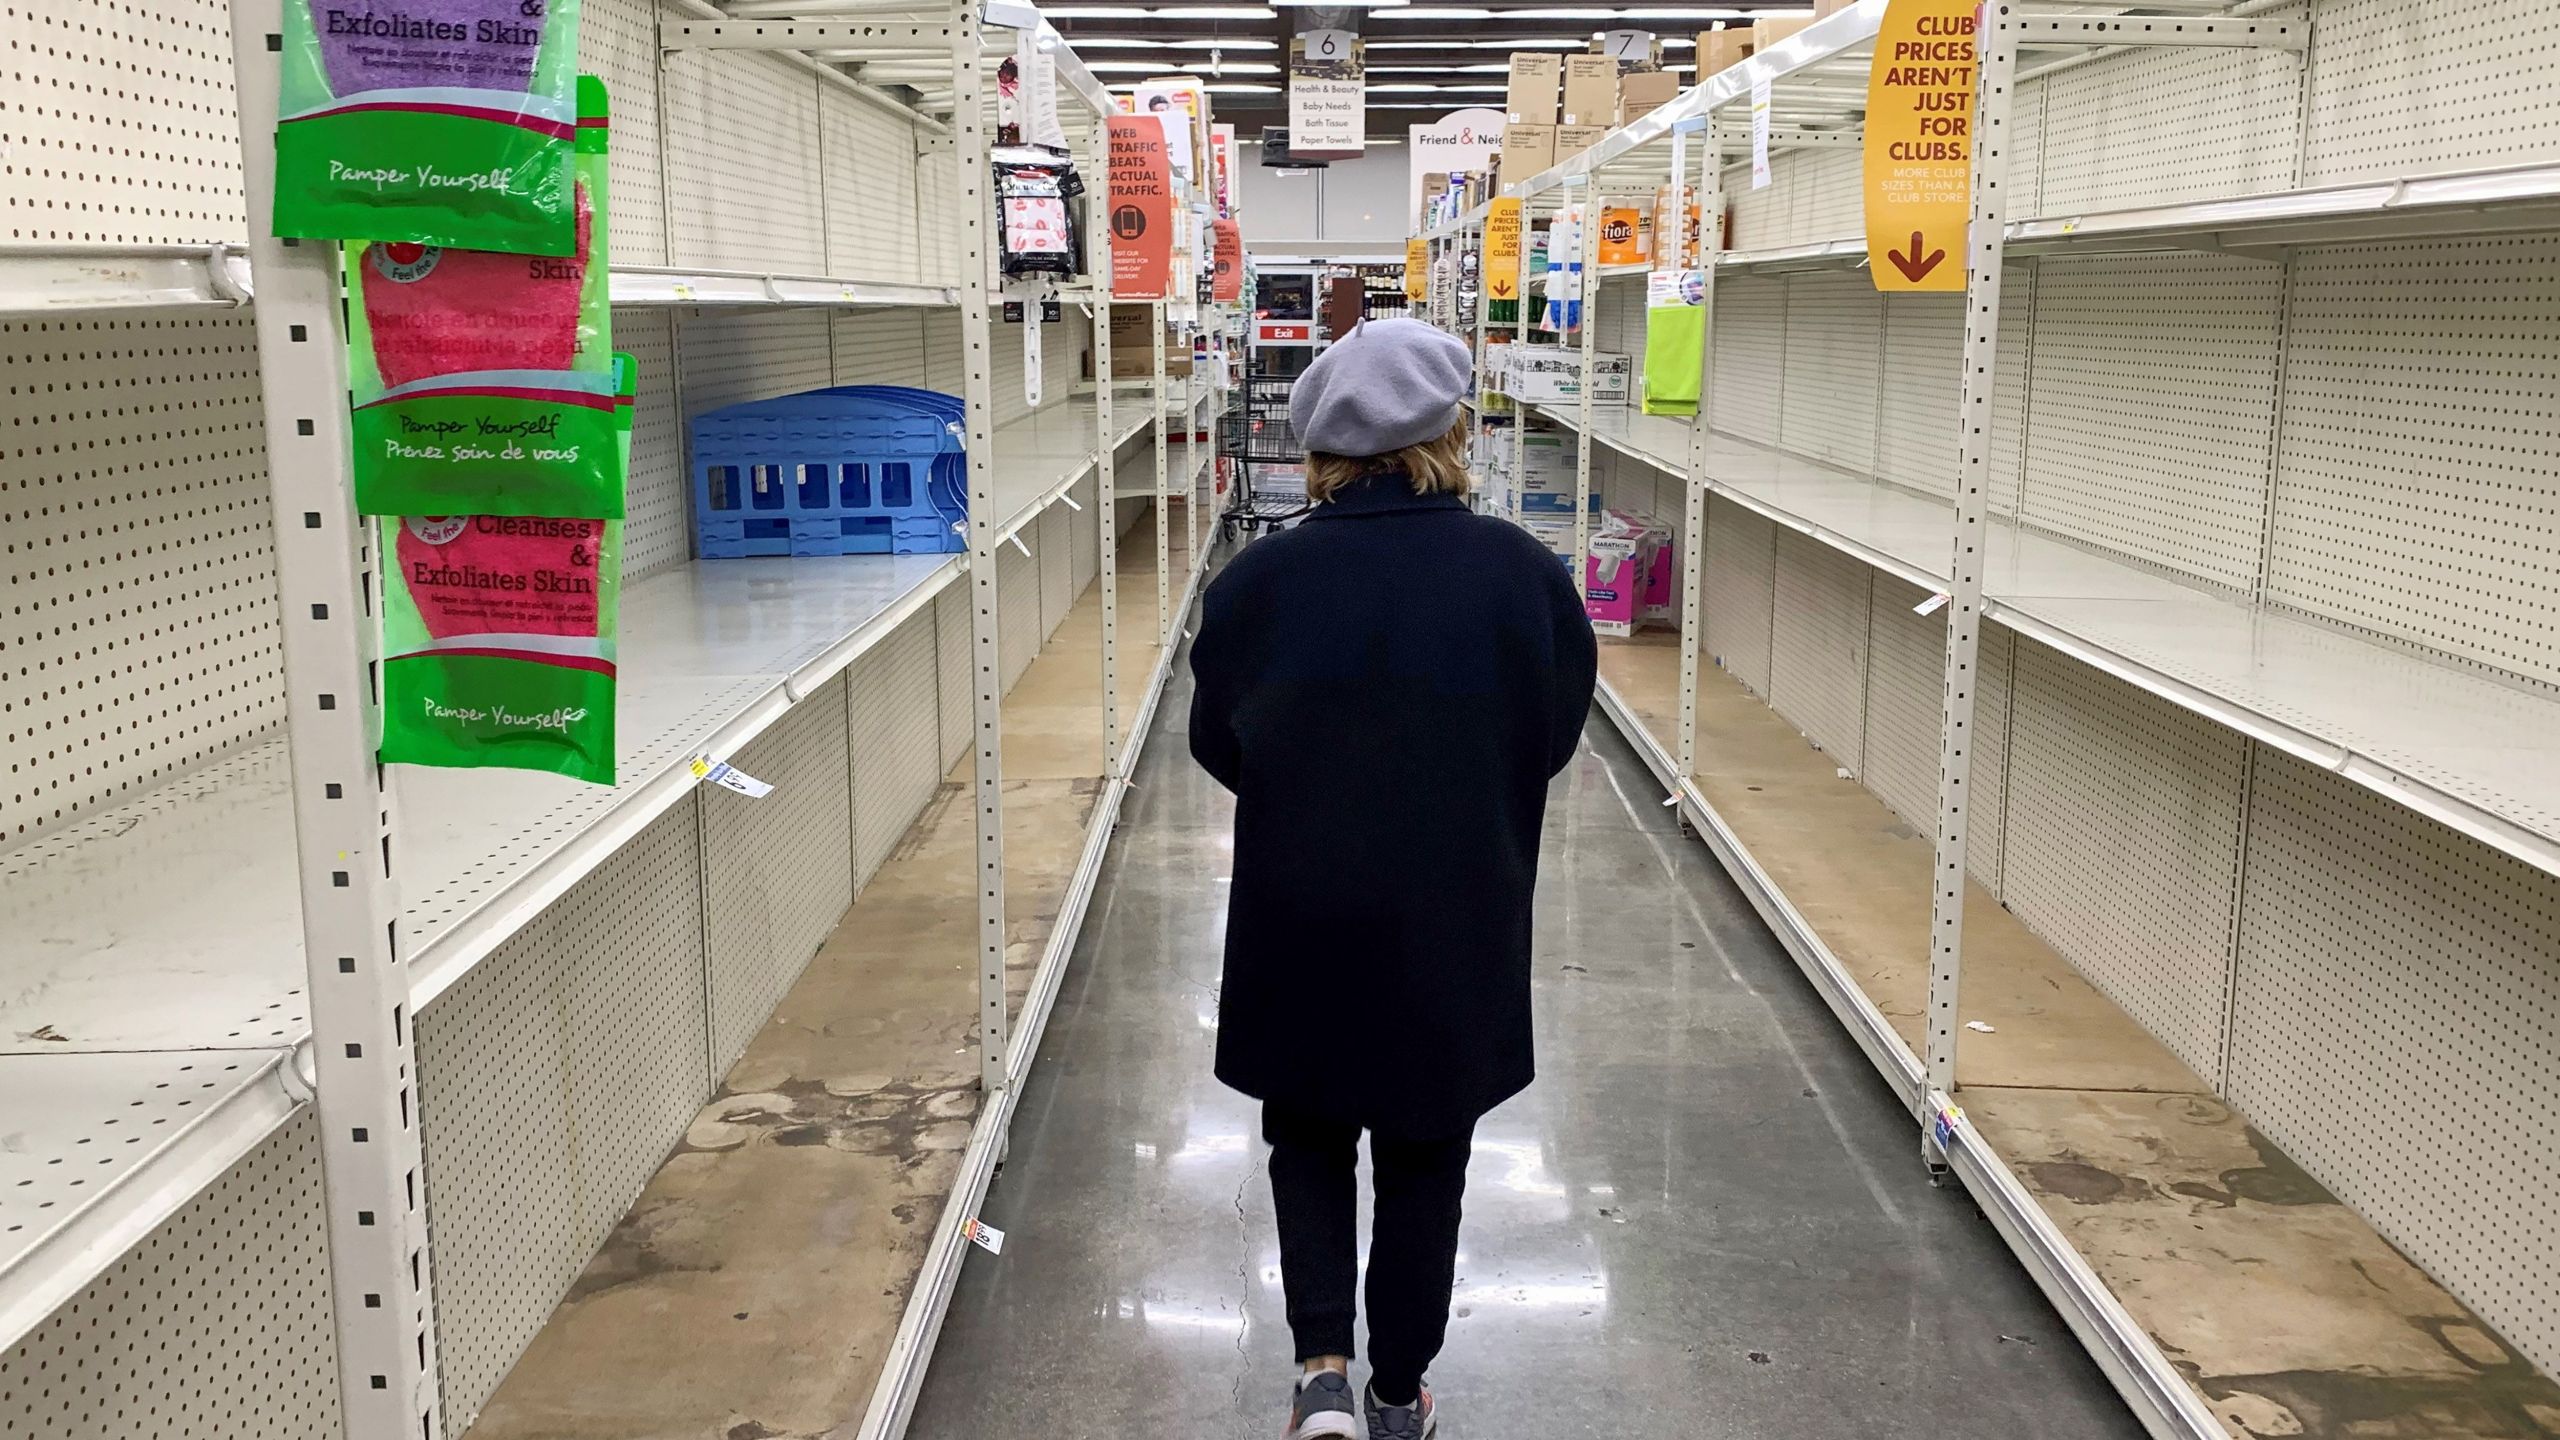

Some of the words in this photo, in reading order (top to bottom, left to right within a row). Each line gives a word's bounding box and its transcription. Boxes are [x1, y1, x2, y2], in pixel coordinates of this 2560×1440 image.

[520, 0, 542, 17] &
[327, 10, 467, 41] Exfoliates
[476, 19, 540, 46] Skin
[1917, 16, 1976, 36] CLUB
[1321, 34, 1335, 55] 6
[1619, 34, 1634, 56] 7
[1894, 41, 1974, 62] PRICES
[1884, 67, 1972, 86] AREN'T
[1294, 85, 1320, 93] Health
[1322, 85, 1329, 93] &
[1331, 85, 1359, 95] Beauty
[1303, 102, 1323, 112] Baby
[1325, 102, 1352, 110] Needs
[1913, 92, 1970, 112] JUST
[1305, 119, 1323, 127] Bath
[1325, 119, 1349, 127] Tissue
[1920, 117, 1967, 136] FOR
[1110, 128, 1137, 139] WEB
[1301, 136, 1323, 145] Paper
[1326, 136, 1353, 144] Towels
[1420, 134, 1457, 145] Friend
[1461, 127, 1474, 145] &
[1110, 142, 1158, 153] TRAFFIC
[1889, 141, 1969, 161] CLUBS.
[1109, 156, 1146, 167] BEATS
[329, 160, 411, 191] Pamper
[417, 165, 514, 197] Yourself
[1110, 171, 1158, 181] ACTUAL
[1893, 167, 1930, 179] MORE
[1934, 167, 1967, 179] CLUB
[1110, 185, 1163, 196] TRAFFIC.
[1881, 179, 1915, 191] SIZES
[1918, 180, 1954, 191] THAN
[1956, 180, 1966, 190] A
[1888, 192, 1920, 203] CLUB
[1603, 222, 1633, 239] fiora
[392, 267, 415, 280] Feel
[529, 259, 580, 281] Skin
[1274, 328, 1294, 338] Exit
[400, 414, 468, 441] Pamper
[476, 413, 562, 440] Yourself
[385, 439, 446, 460] Prenez
[452, 444, 495, 464] soin
[500, 440, 525, 460] de
[533, 446, 581, 464] vous
[421, 527, 441, 541] Feel
[443, 523, 461, 538] the
[475, 516, 592, 540] Cleanses
[1594, 541, 1630, 549] MARATHON
[571, 544, 592, 567] &
[413, 562, 527, 591] Exfoliates
[534, 570, 592, 594] Skin
[424, 697, 486, 728] Pamper
[492, 706, 569, 734] Yourself
